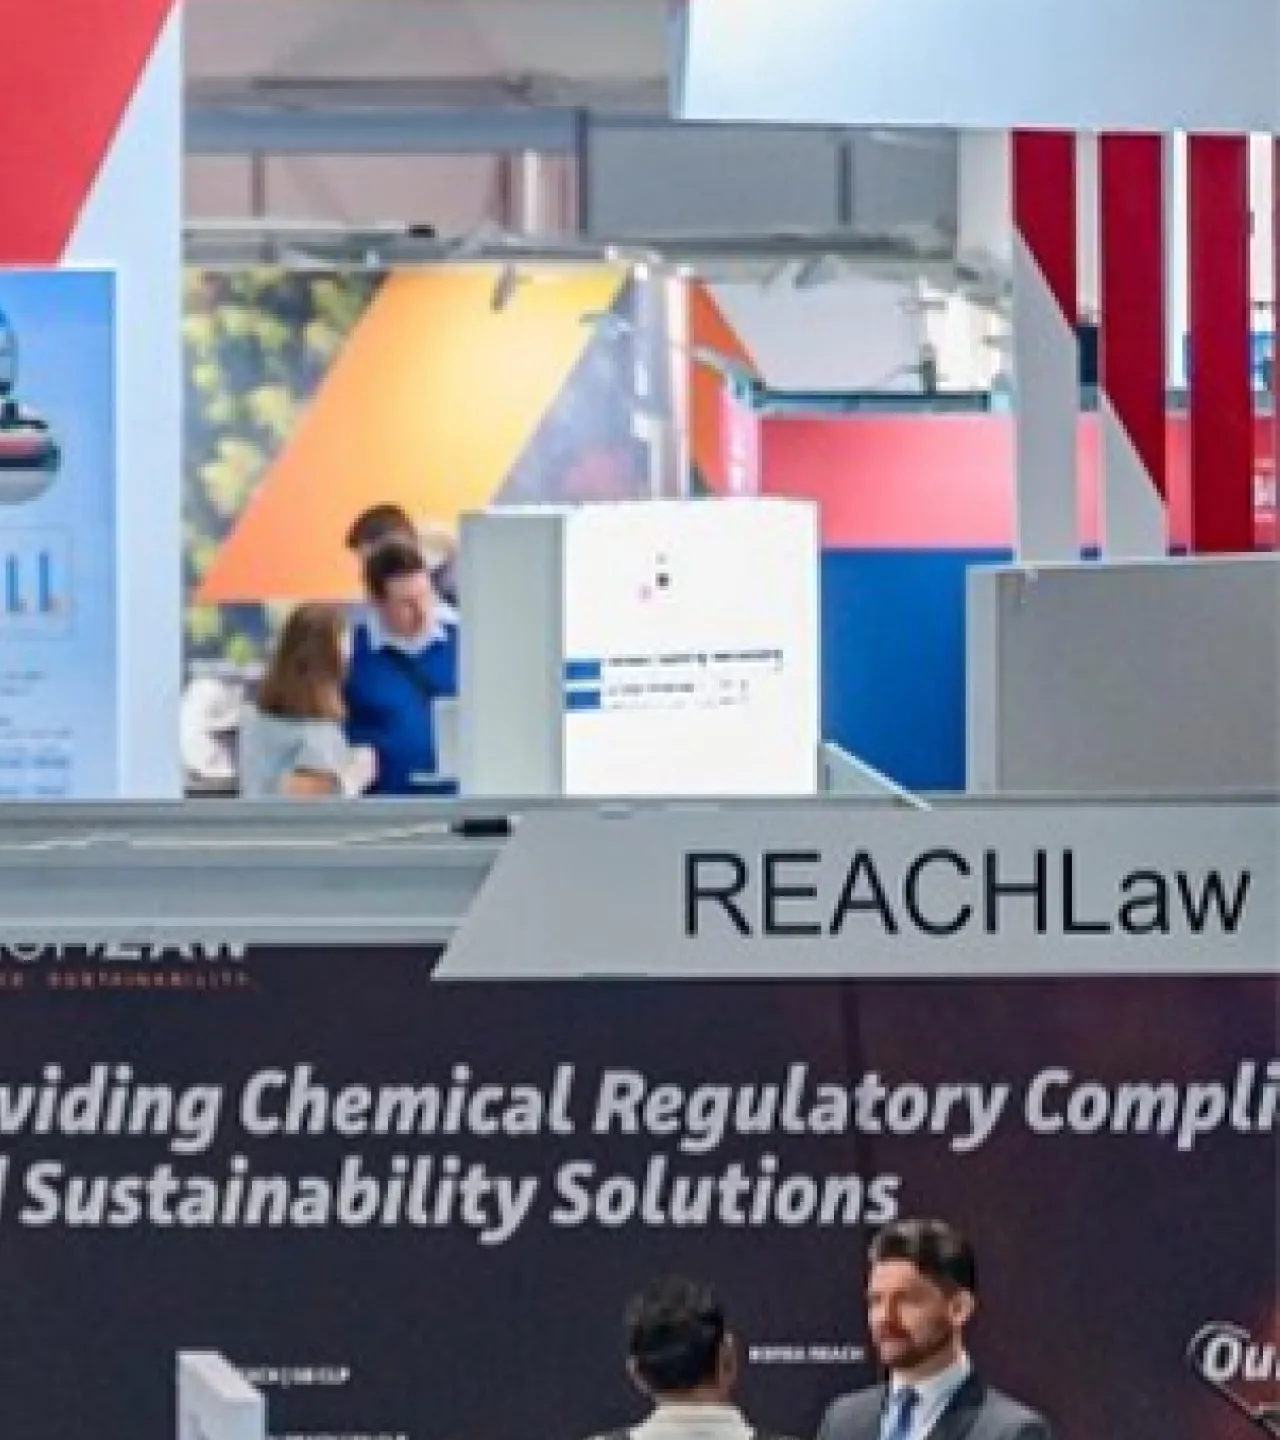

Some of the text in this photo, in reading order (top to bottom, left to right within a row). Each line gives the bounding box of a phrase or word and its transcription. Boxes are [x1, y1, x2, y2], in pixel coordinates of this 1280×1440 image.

[683, 847, 1251, 937] REACHLaw
[239, 1063, 576, 1136] Chemical
[592, 1063, 1011, 1153] Regulatory
[19, 1154, 539, 1246] Sustainability
[549, 1154, 903, 1227] Solutions
[1203, 1333, 1280, 1382] Ou
